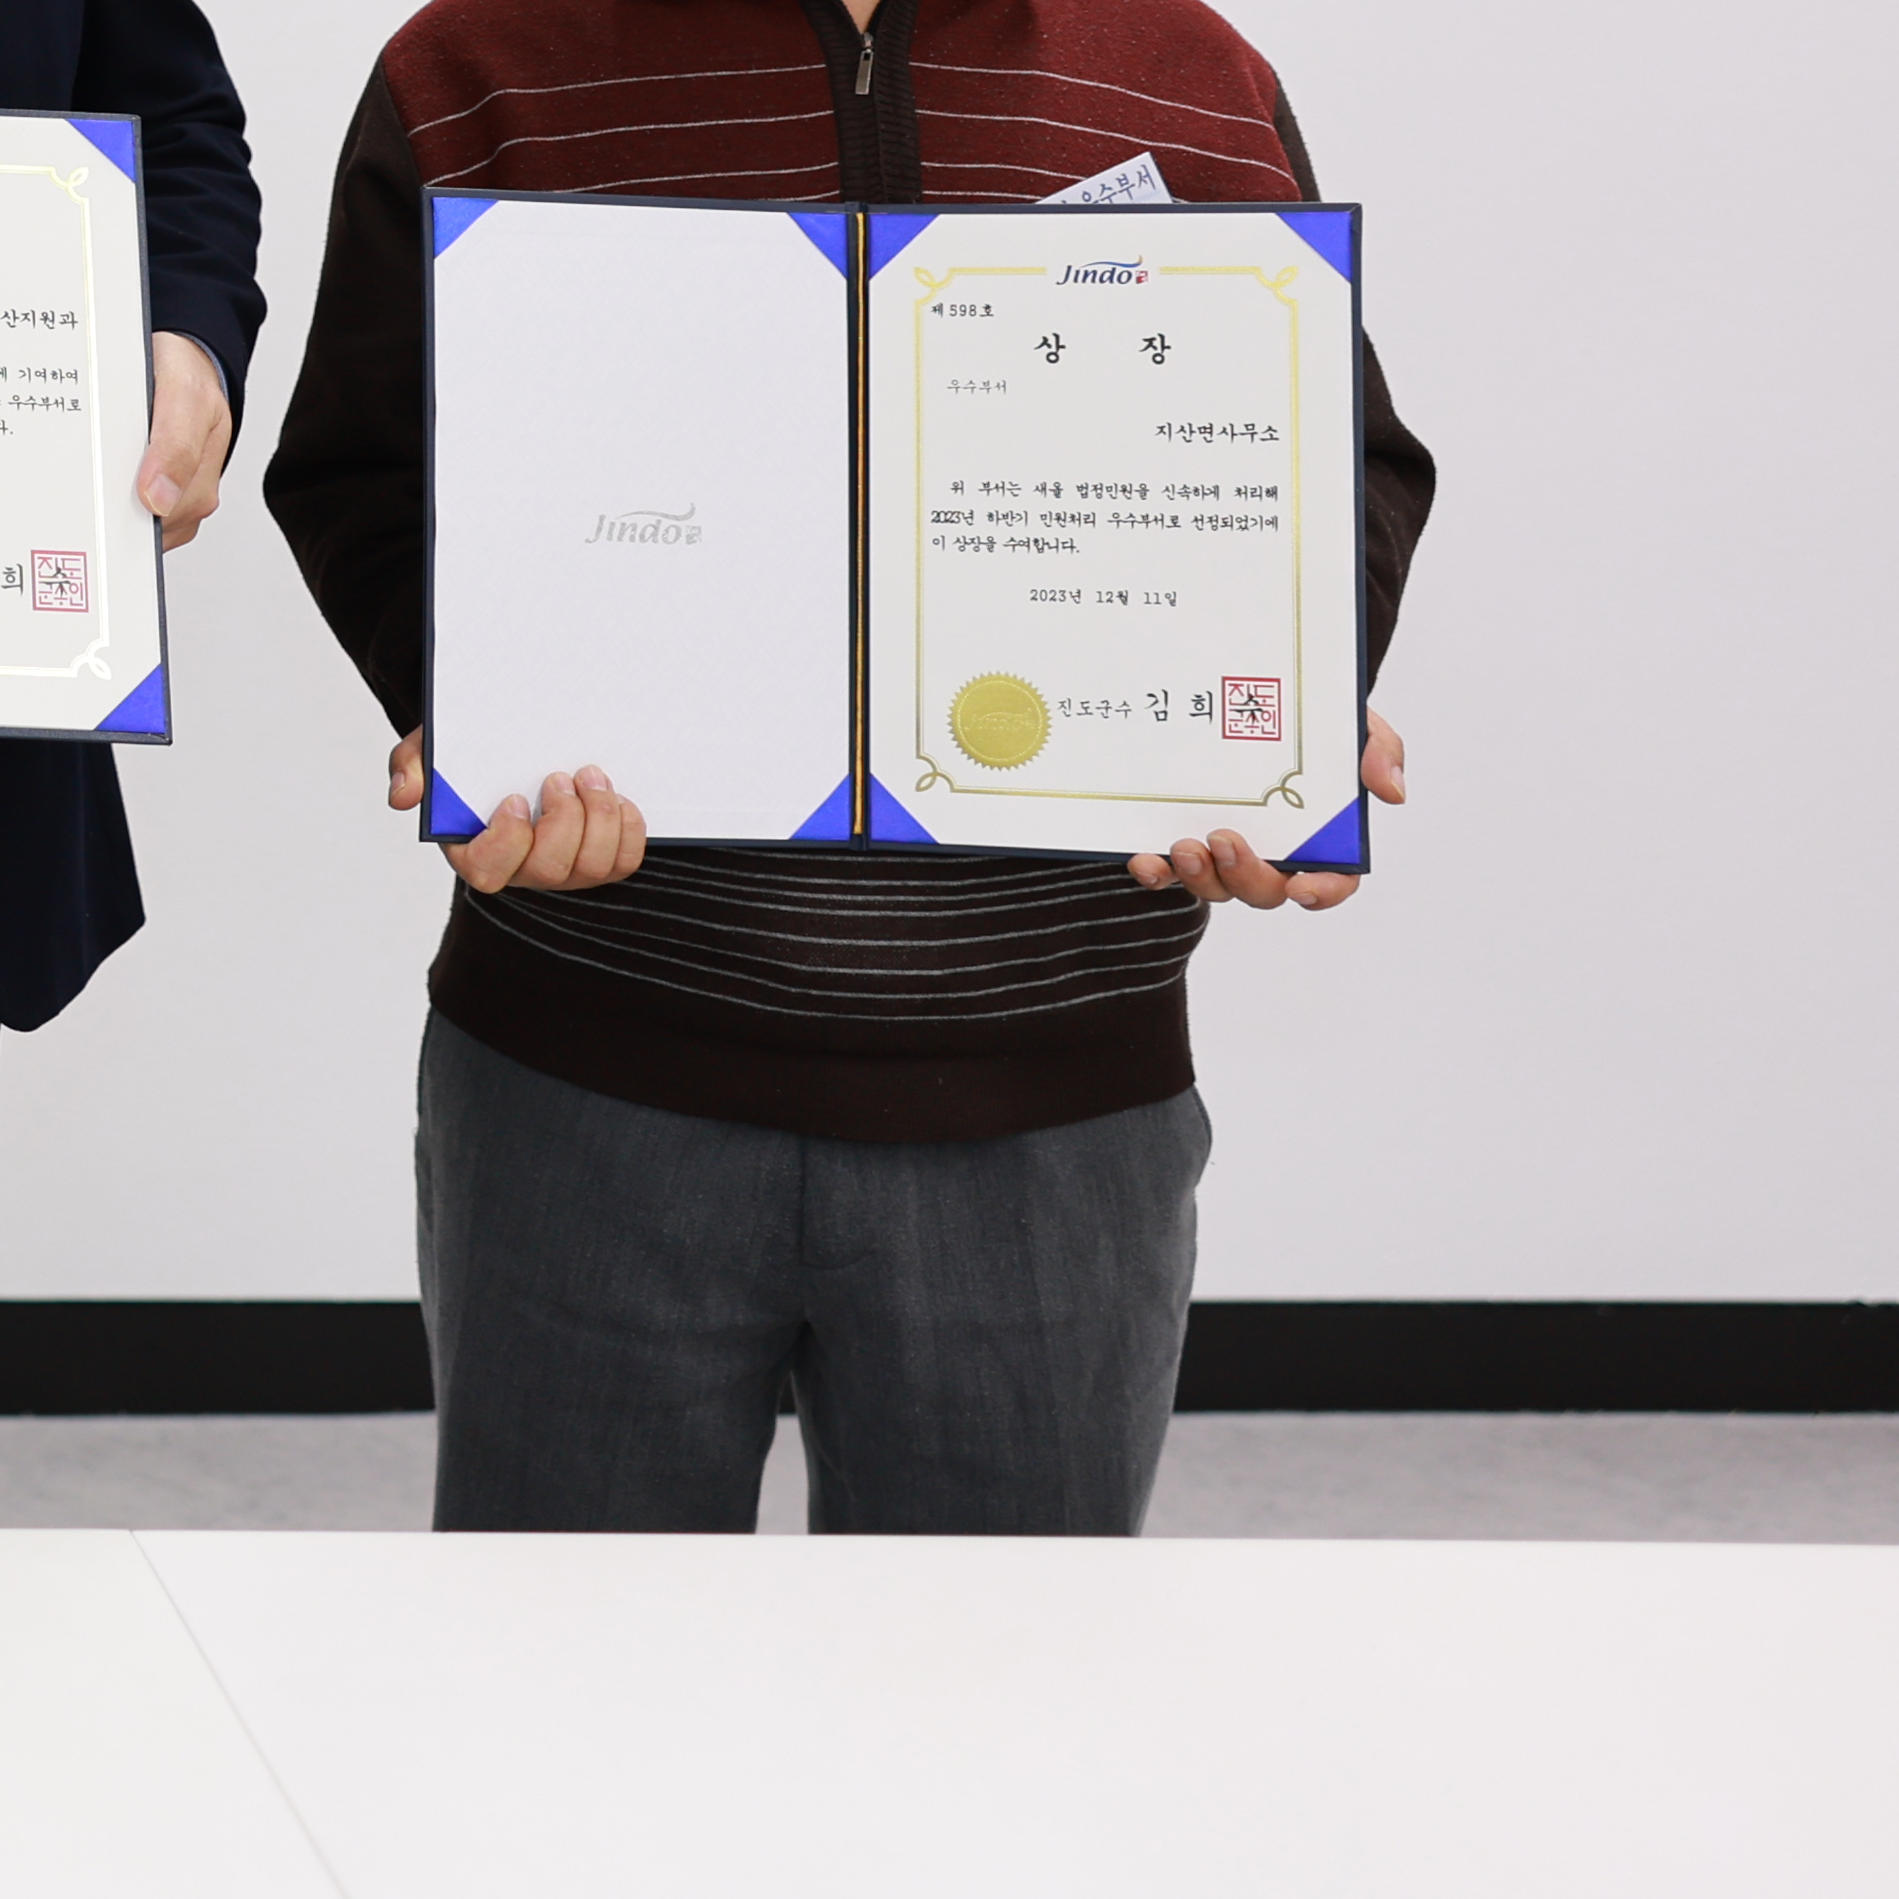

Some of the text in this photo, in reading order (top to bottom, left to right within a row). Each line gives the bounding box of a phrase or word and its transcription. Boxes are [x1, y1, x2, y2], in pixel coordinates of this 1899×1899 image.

[1055, 265, 1133, 285] Jindo
[1033, 332, 1172, 365] 상 장
[17, 367, 79, 386] 기여하여
[946, 379, 1008, 395] 우수부서
[7, 394, 82, 413] 우수부서로
[1155, 421, 1280, 444] 지산면사무소
[950, 479, 1279, 502] 위 부서는 새올 법정민원을 신속하게 처리해
[930, 508, 1279, 532] 2023년 하반기 민원처리 우수부서로 선정되었기에
[932, 534, 1081, 555] 이 상장을 수여합니다.
[1029, 589, 1178, 607] 2023년 12월 11일
[1056, 697, 1133, 720] 진도군수
